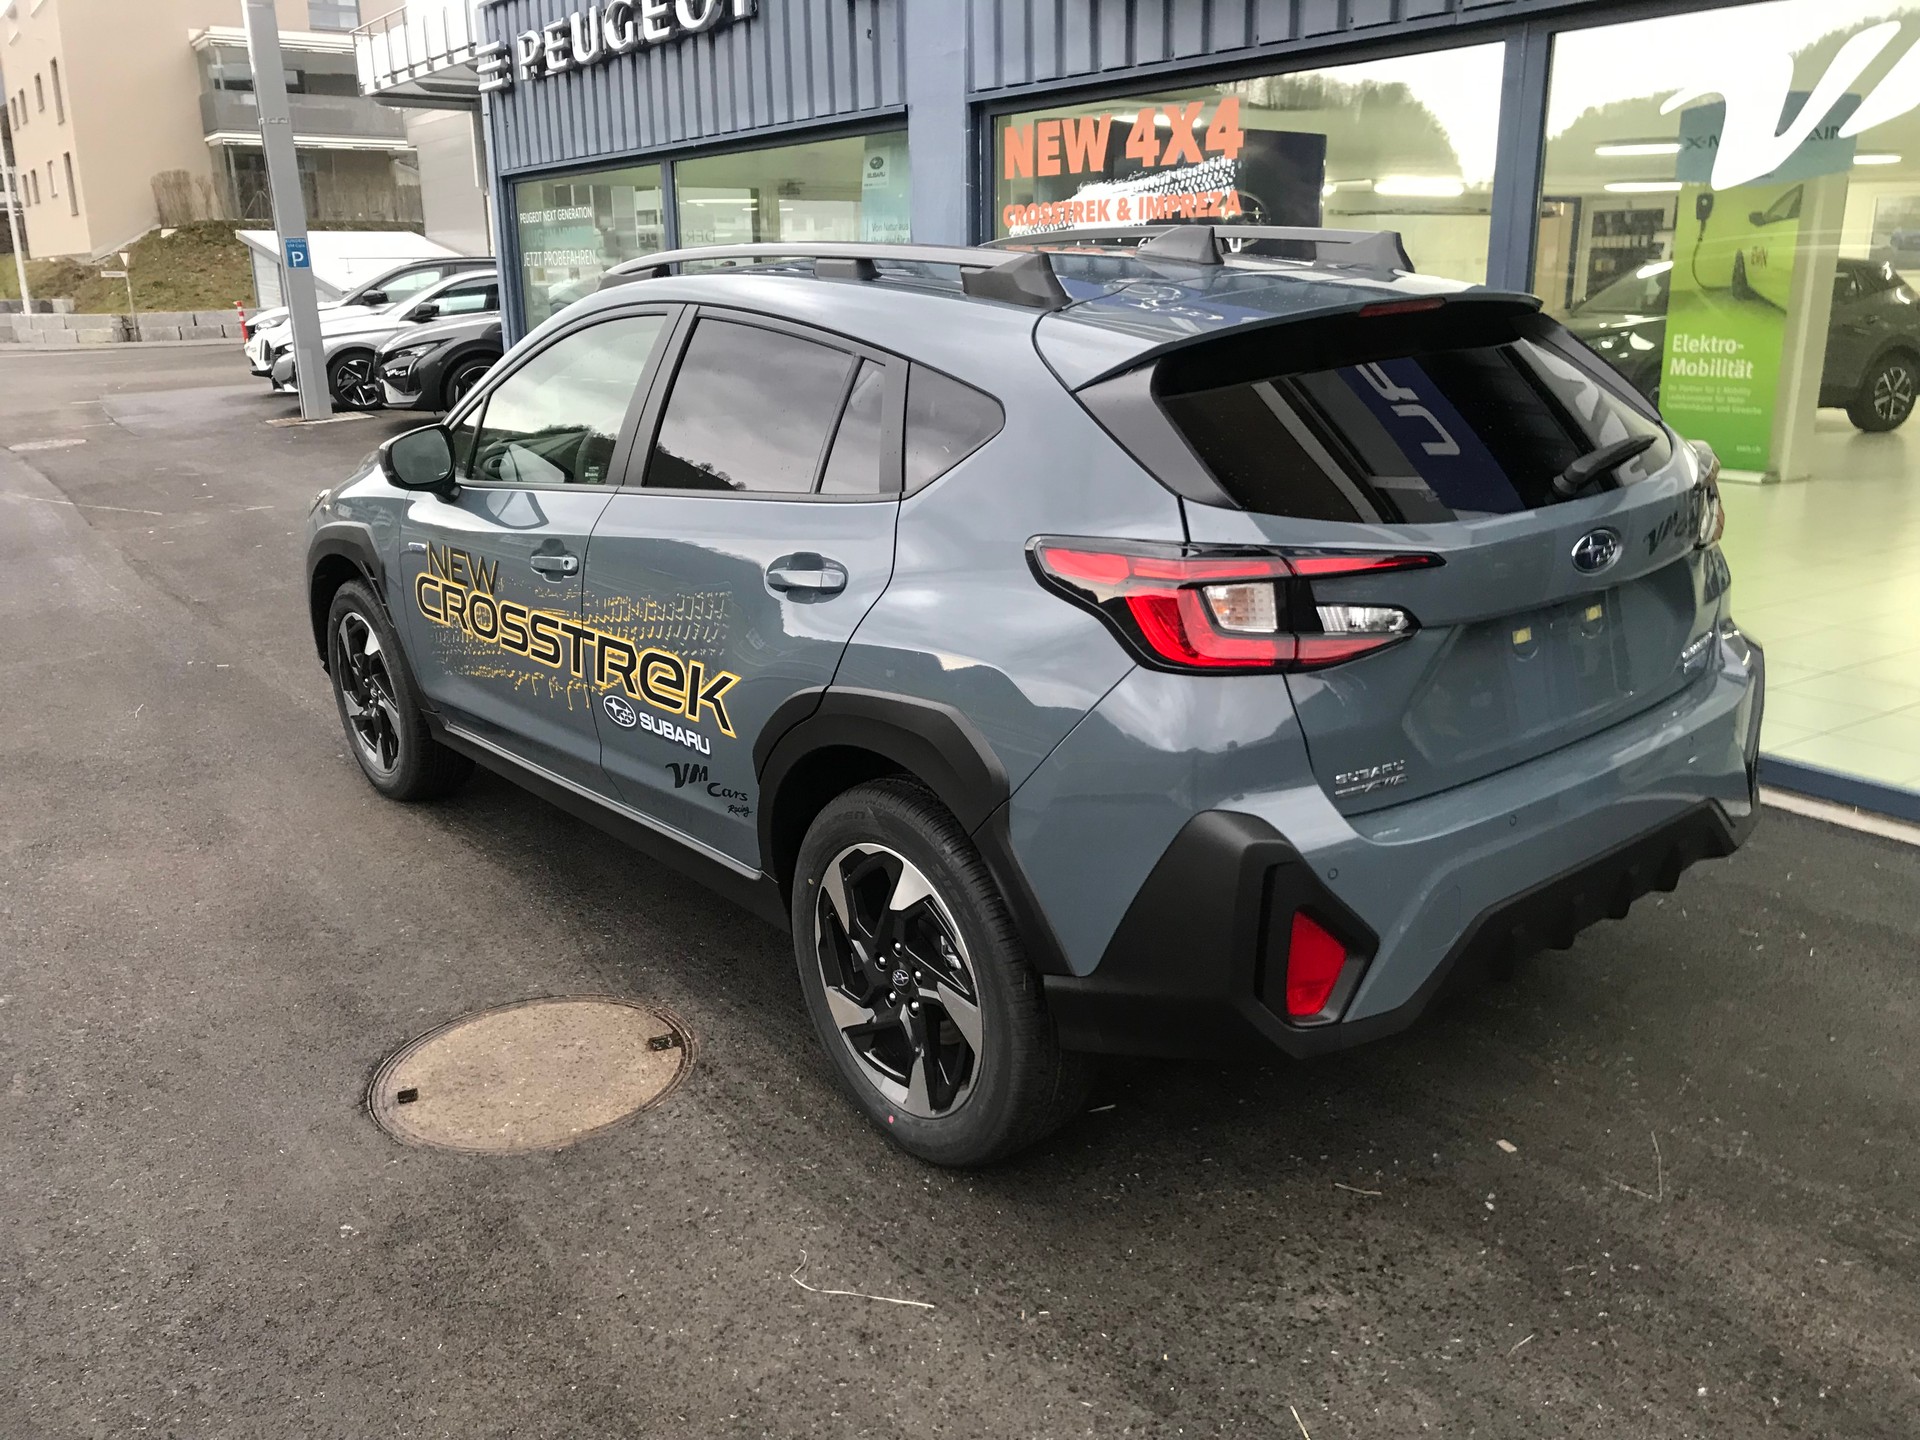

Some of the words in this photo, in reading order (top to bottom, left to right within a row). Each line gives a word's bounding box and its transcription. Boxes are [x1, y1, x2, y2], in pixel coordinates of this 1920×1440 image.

[1004, 114, 1112, 180] NEW
[1125, 97, 1244, 168] 4X4
[520, 211, 542, 224] PEUGEOT
[543, 209, 556, 221] NEXT
[557, 206, 593, 221] GENERATION
[1003, 199, 1111, 228] CROSSTREK
[1116, 197, 1131, 221] &
[1138, 190, 1242, 220] IMPREZA
[291, 251, 304, 267] P
[523, 251, 543, 267] JETZT
[543, 249, 596, 266] PROBEFAHREN
[1672, 333, 1744, 354] Elektro-
[1669, 357, 1754, 379] Mobilität
[426, 541, 500, 596] NEW
[639, 712, 711, 755] SUBARU
[665, 762, 708, 789] VM
[707, 782, 749, 802] Cars
